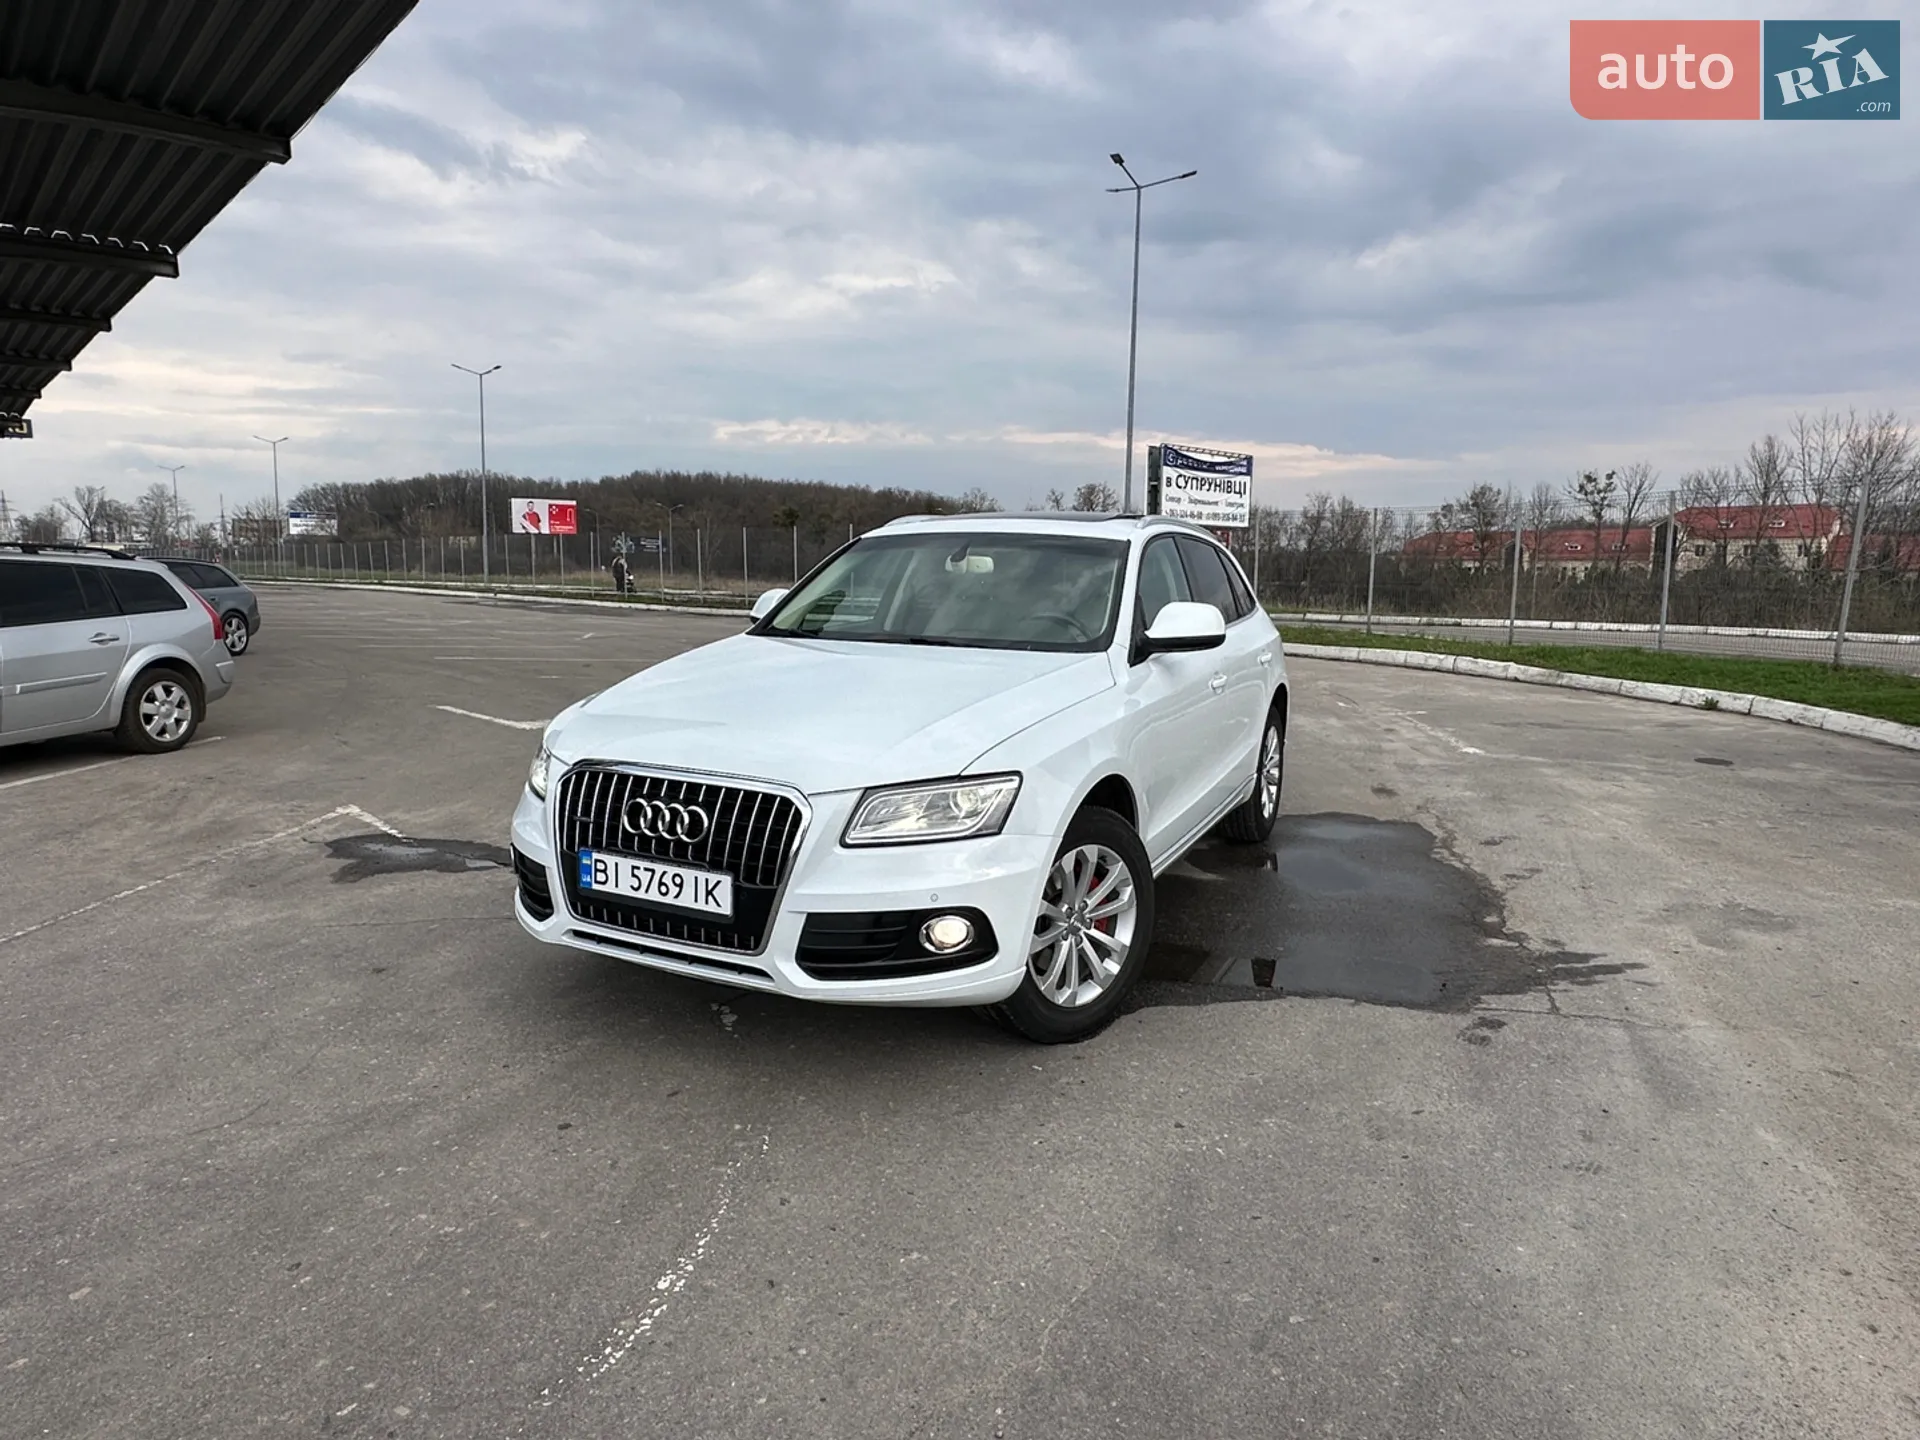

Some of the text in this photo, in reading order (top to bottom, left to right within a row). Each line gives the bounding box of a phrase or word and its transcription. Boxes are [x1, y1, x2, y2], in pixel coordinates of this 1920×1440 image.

[1175, 474, 1247, 498] СУПРУНІВЦІ
[594, 858, 722, 908] BI 5769 IK
